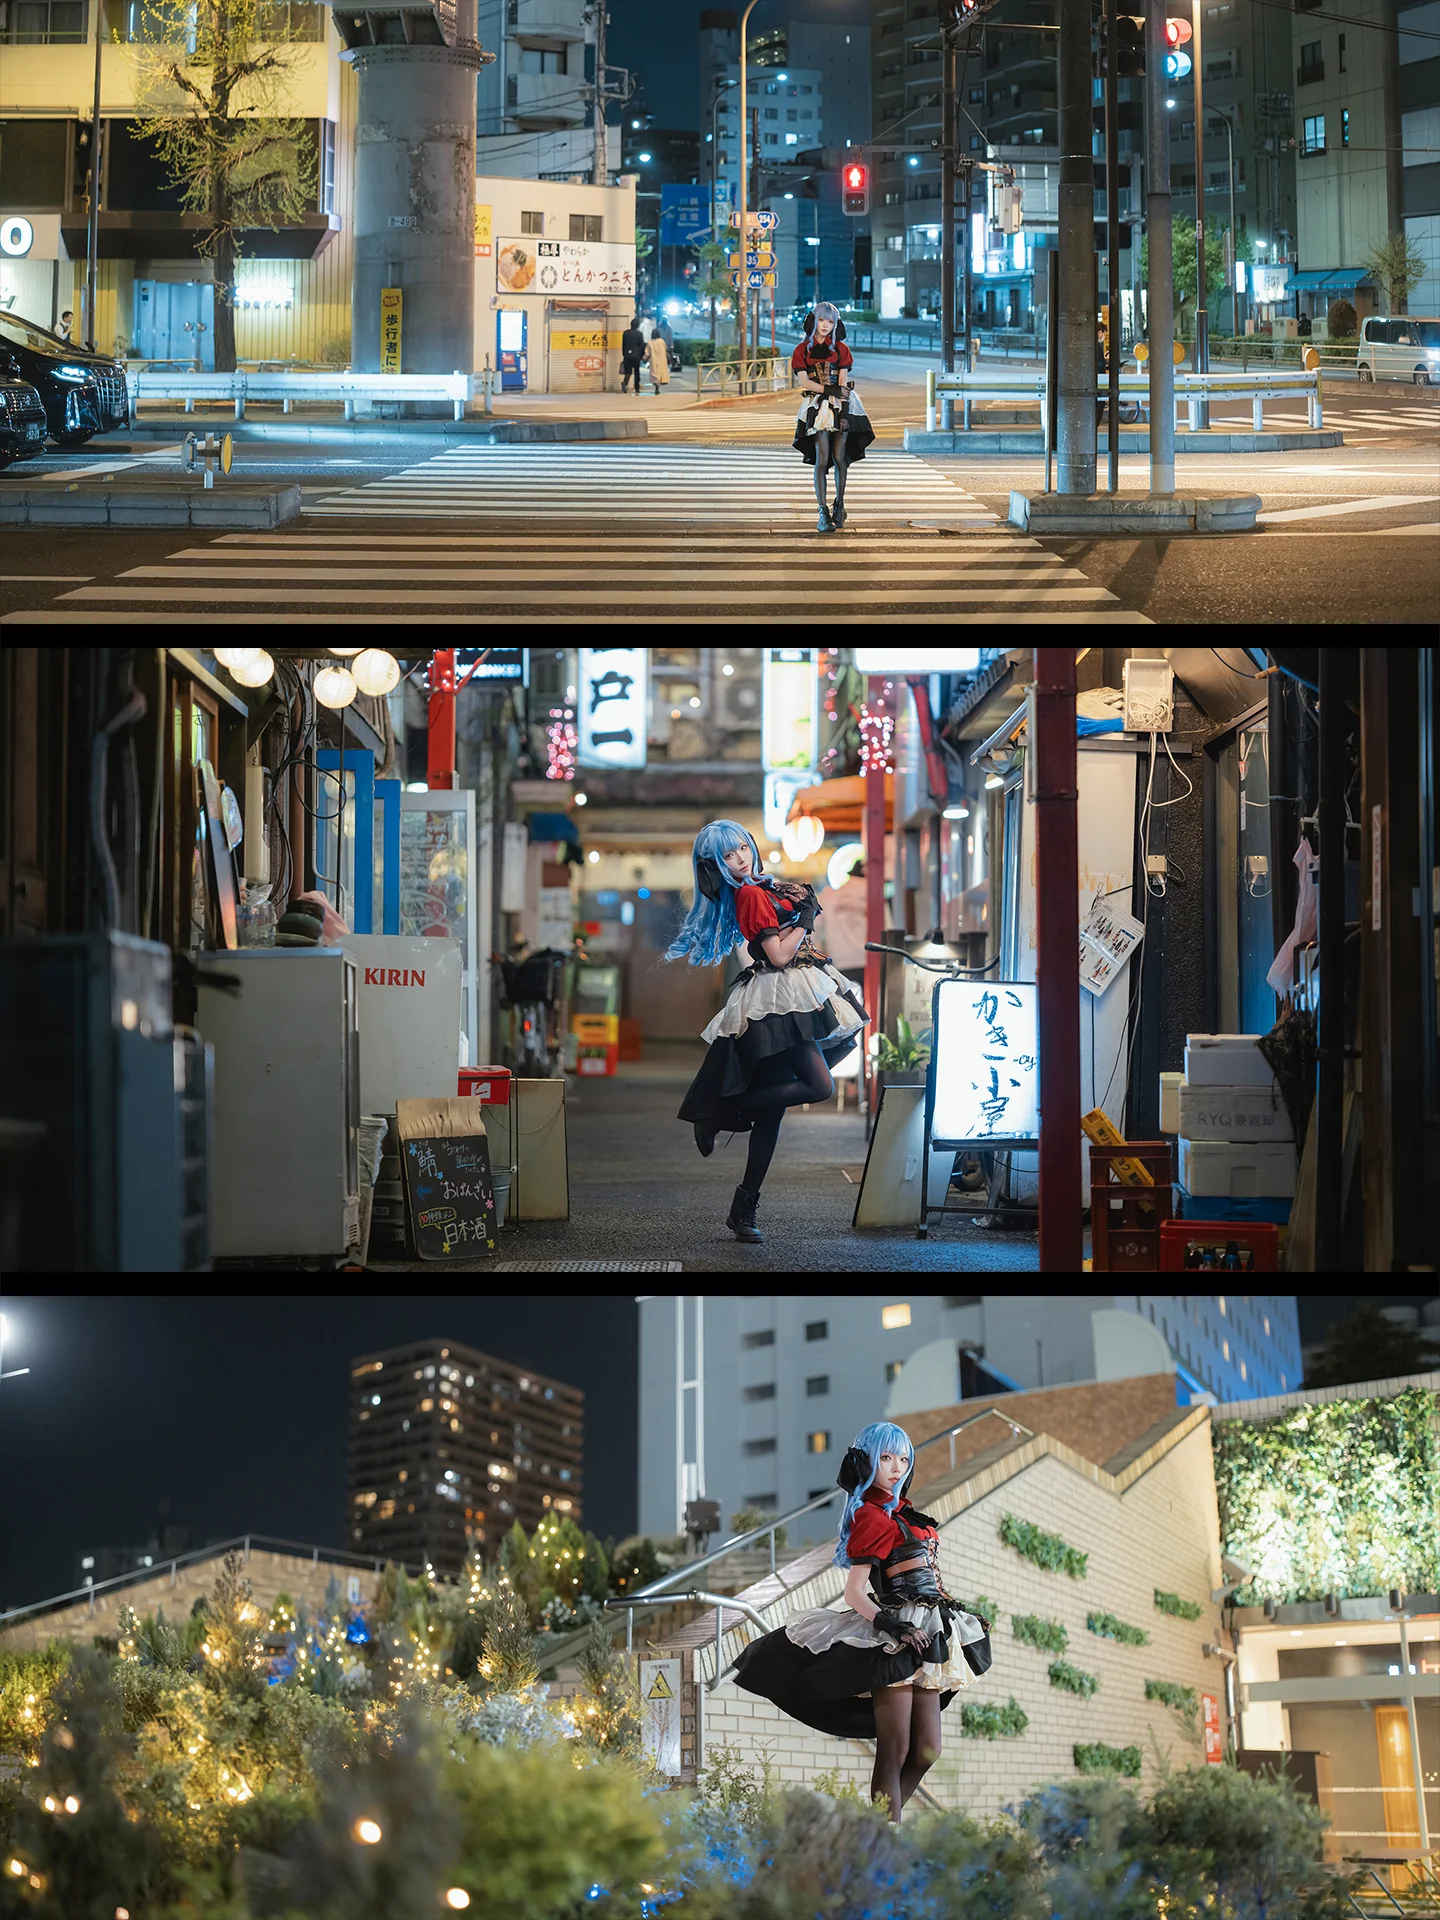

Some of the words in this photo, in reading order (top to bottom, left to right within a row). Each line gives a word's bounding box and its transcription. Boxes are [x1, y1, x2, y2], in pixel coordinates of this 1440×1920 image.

[562, 246, 590, 257] やわらか
[561, 268, 633, 285] とんかつ二矢
[748, 275, 763, 285] 441
[364, 967, 426, 987] KIRIN
[417, 1147, 438, 1177] 鯖
[443, 1180, 492, 1200] おばんざい
[444, 1217, 487, 1246] 日本酒
